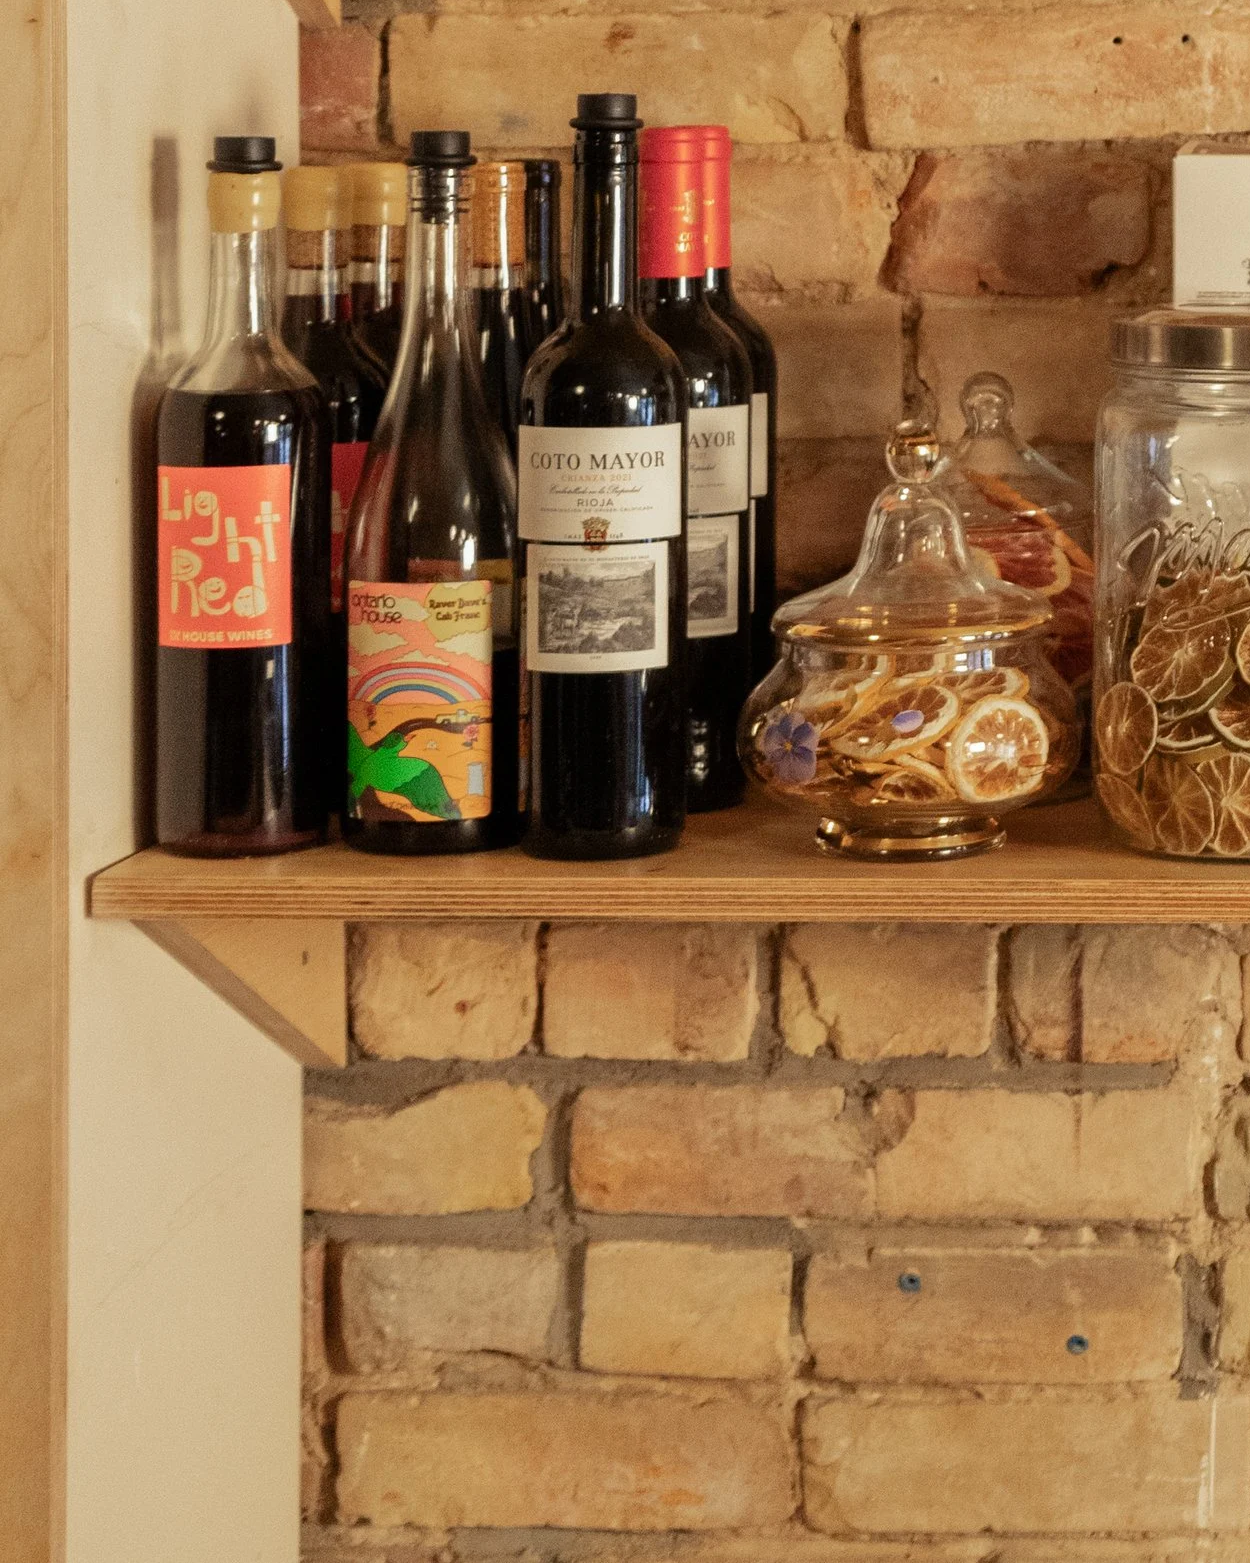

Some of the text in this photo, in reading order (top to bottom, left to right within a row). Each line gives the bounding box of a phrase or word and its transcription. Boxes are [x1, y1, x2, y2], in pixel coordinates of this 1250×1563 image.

[689, 431, 736, 449] AYOR
[530, 450, 665, 470] COTO MAYOR
[561, 473, 632, 482] CRIANZA 2021
[577, 498, 614, 508] RIOJA
[161, 476, 281, 562] Light
[171, 547, 268, 618] Red
[352, 593, 396, 610] ontario
[361, 606, 402, 624] house
[181, 630, 225, 643] HOUSE
[227, 628, 273, 642] WINES
